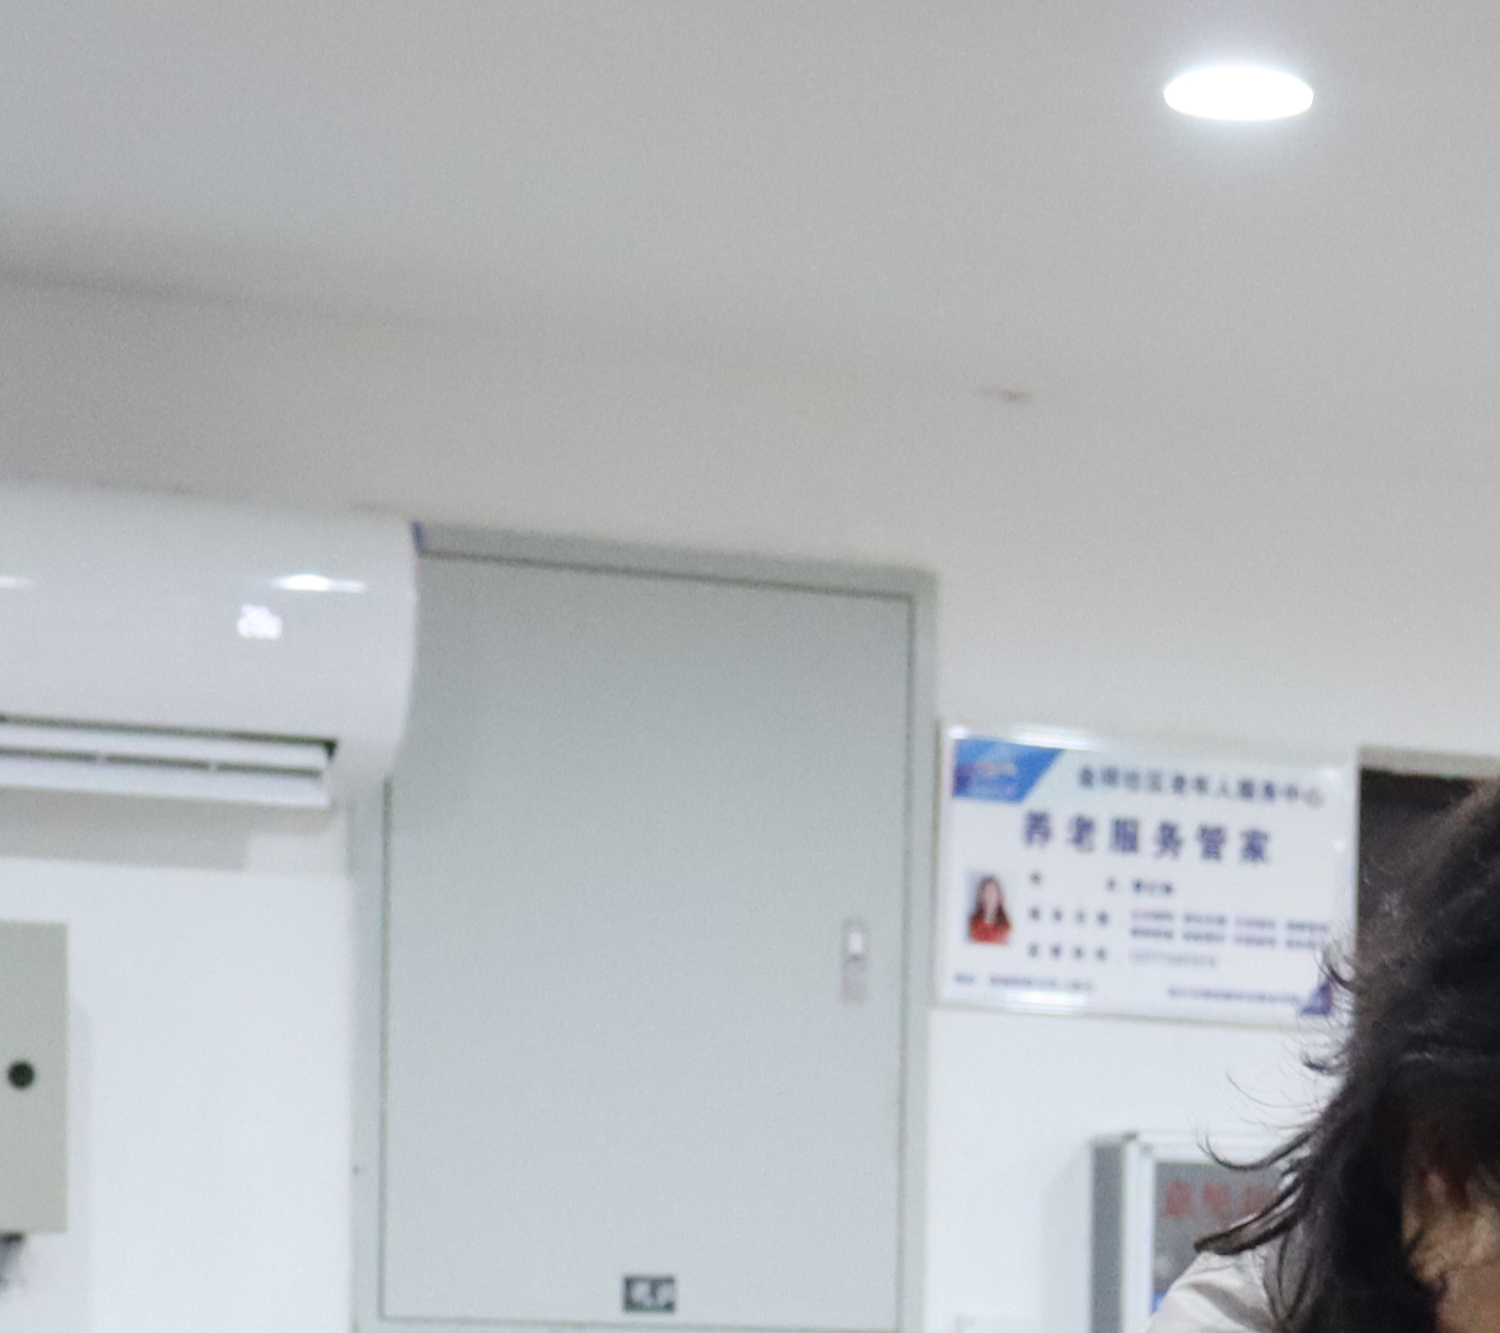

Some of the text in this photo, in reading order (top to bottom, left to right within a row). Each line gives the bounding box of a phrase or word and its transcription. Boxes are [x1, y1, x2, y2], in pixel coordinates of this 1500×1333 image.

[1022, 811, 1271, 864] 养老服务管家
